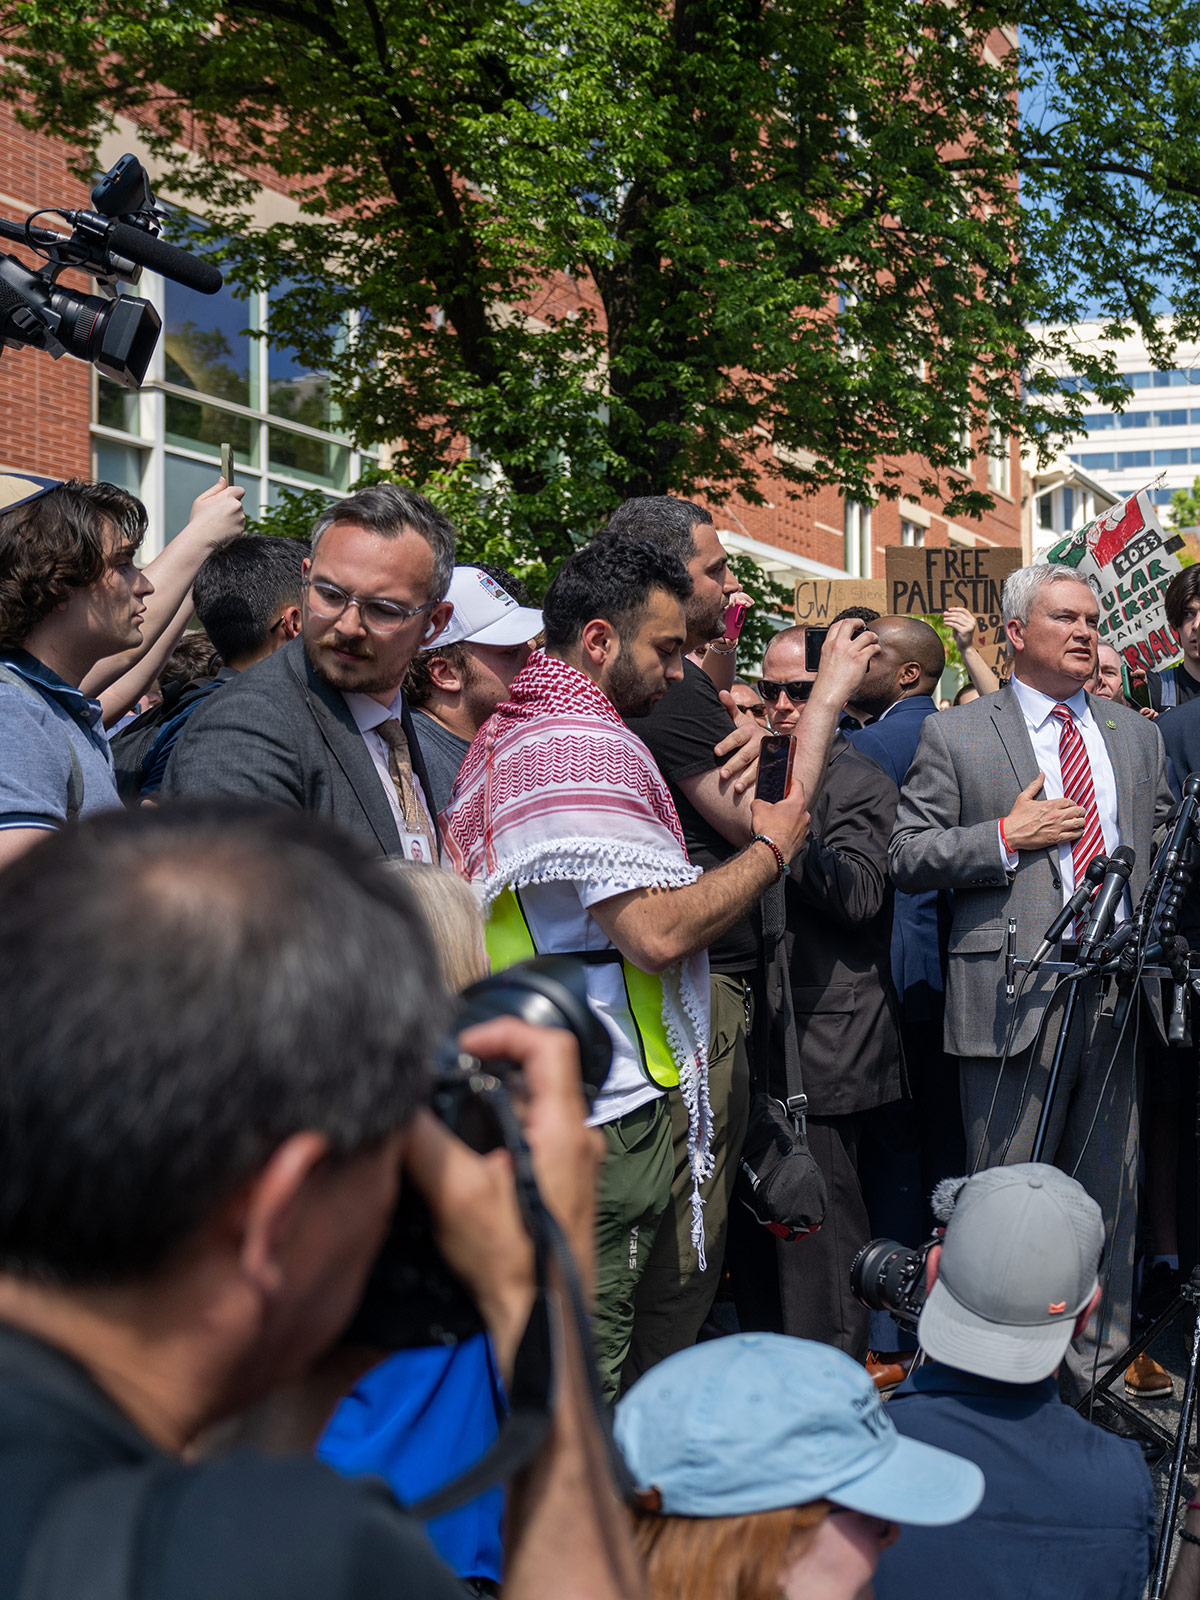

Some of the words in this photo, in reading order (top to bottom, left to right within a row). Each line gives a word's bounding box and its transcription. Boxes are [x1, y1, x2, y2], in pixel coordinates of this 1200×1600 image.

[925, 549, 990, 579] FREE
[1115, 535, 1159, 573] 2023
[796, 581, 831, 619] GW
[893, 579, 1004, 615] PALESTIN
[1101, 558, 1171, 612] ULAR
[1097, 574, 1176, 637] VERSIT
[1107, 604, 1166, 647] AINST
[629, 1225, 640, 1270] VIRUS
